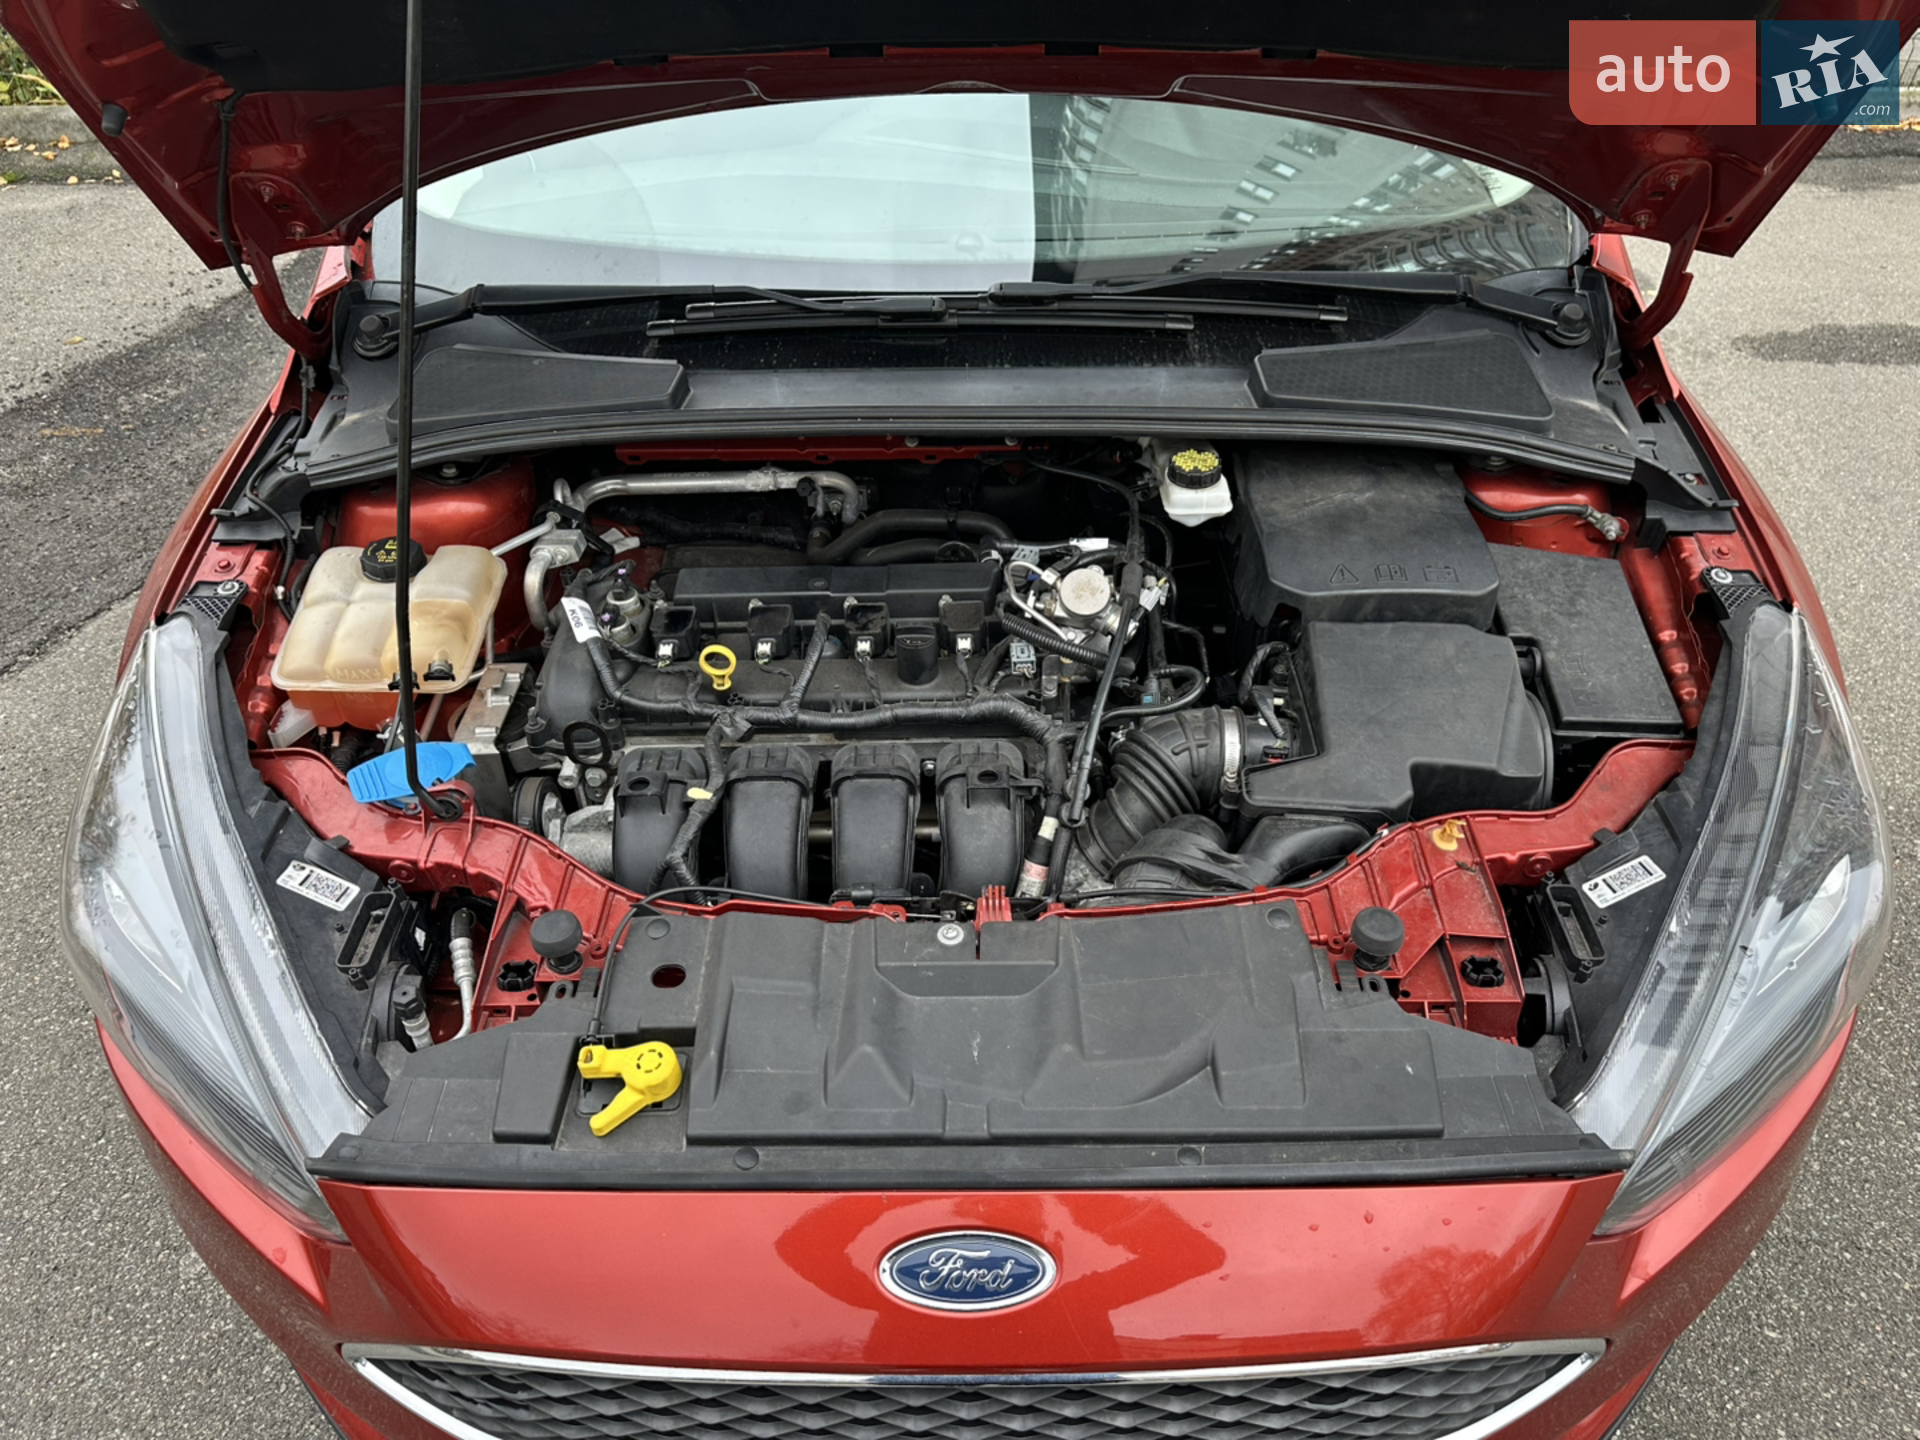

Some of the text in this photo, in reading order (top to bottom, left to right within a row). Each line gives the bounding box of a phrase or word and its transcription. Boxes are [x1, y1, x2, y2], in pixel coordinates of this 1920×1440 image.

[568, 608, 584, 629] K06
[345, 692, 375, 704] MIN
[919, 1247, 1016, 1292] Ford
